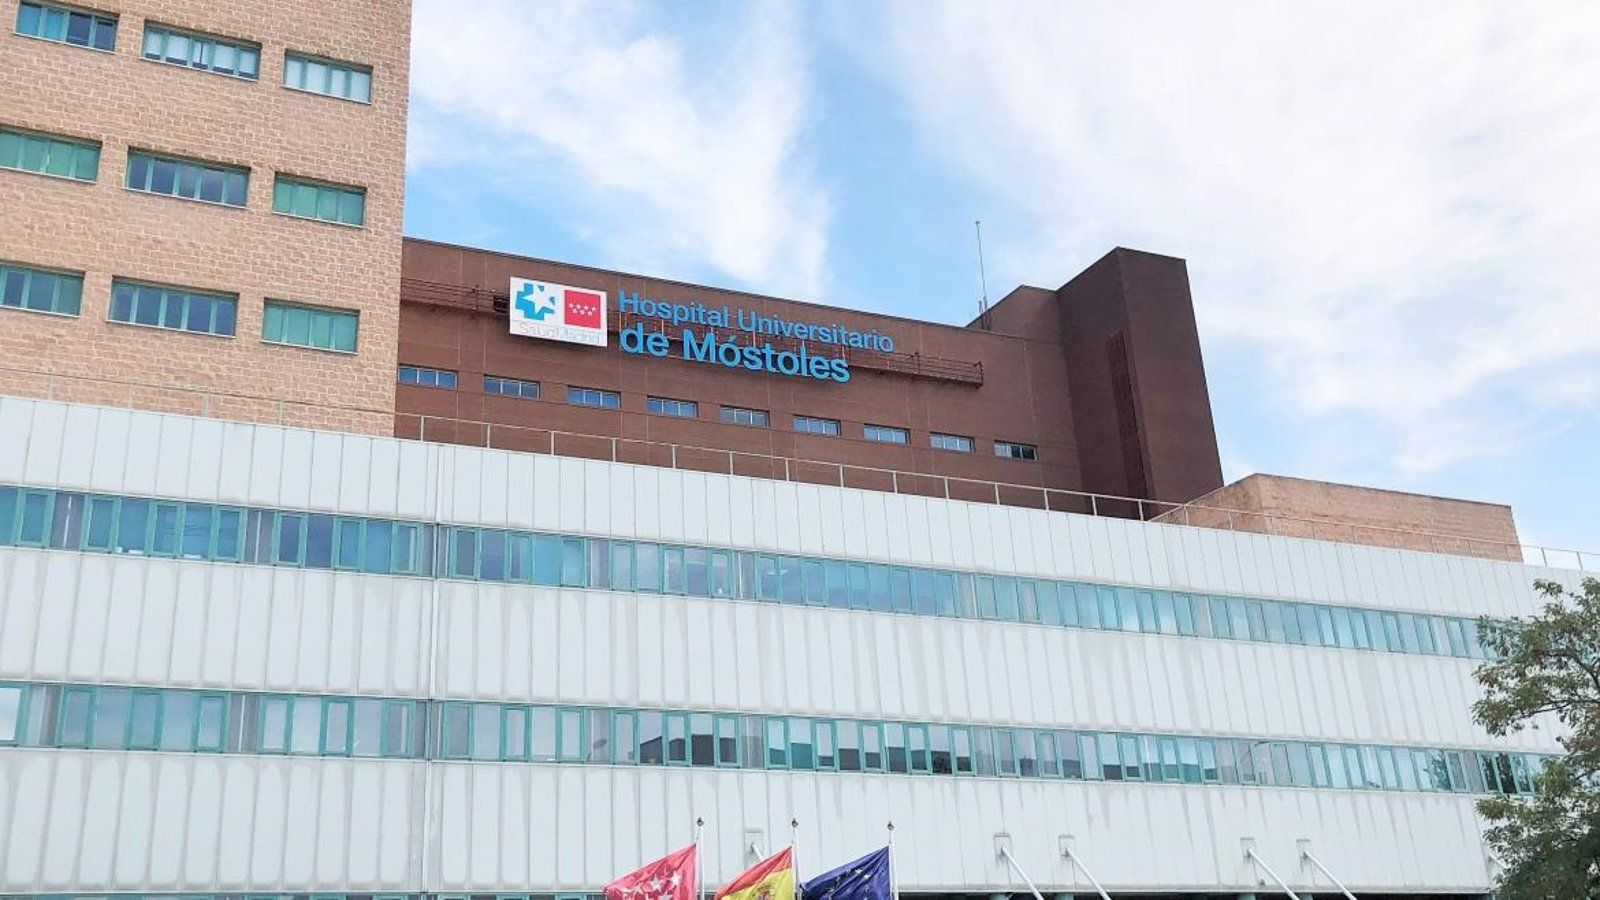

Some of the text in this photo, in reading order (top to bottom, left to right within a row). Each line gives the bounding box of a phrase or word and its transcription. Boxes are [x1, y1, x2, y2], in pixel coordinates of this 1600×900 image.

[619, 291, 894, 352] Hospital Universitario
[620, 323, 850, 383] de Móstoles
